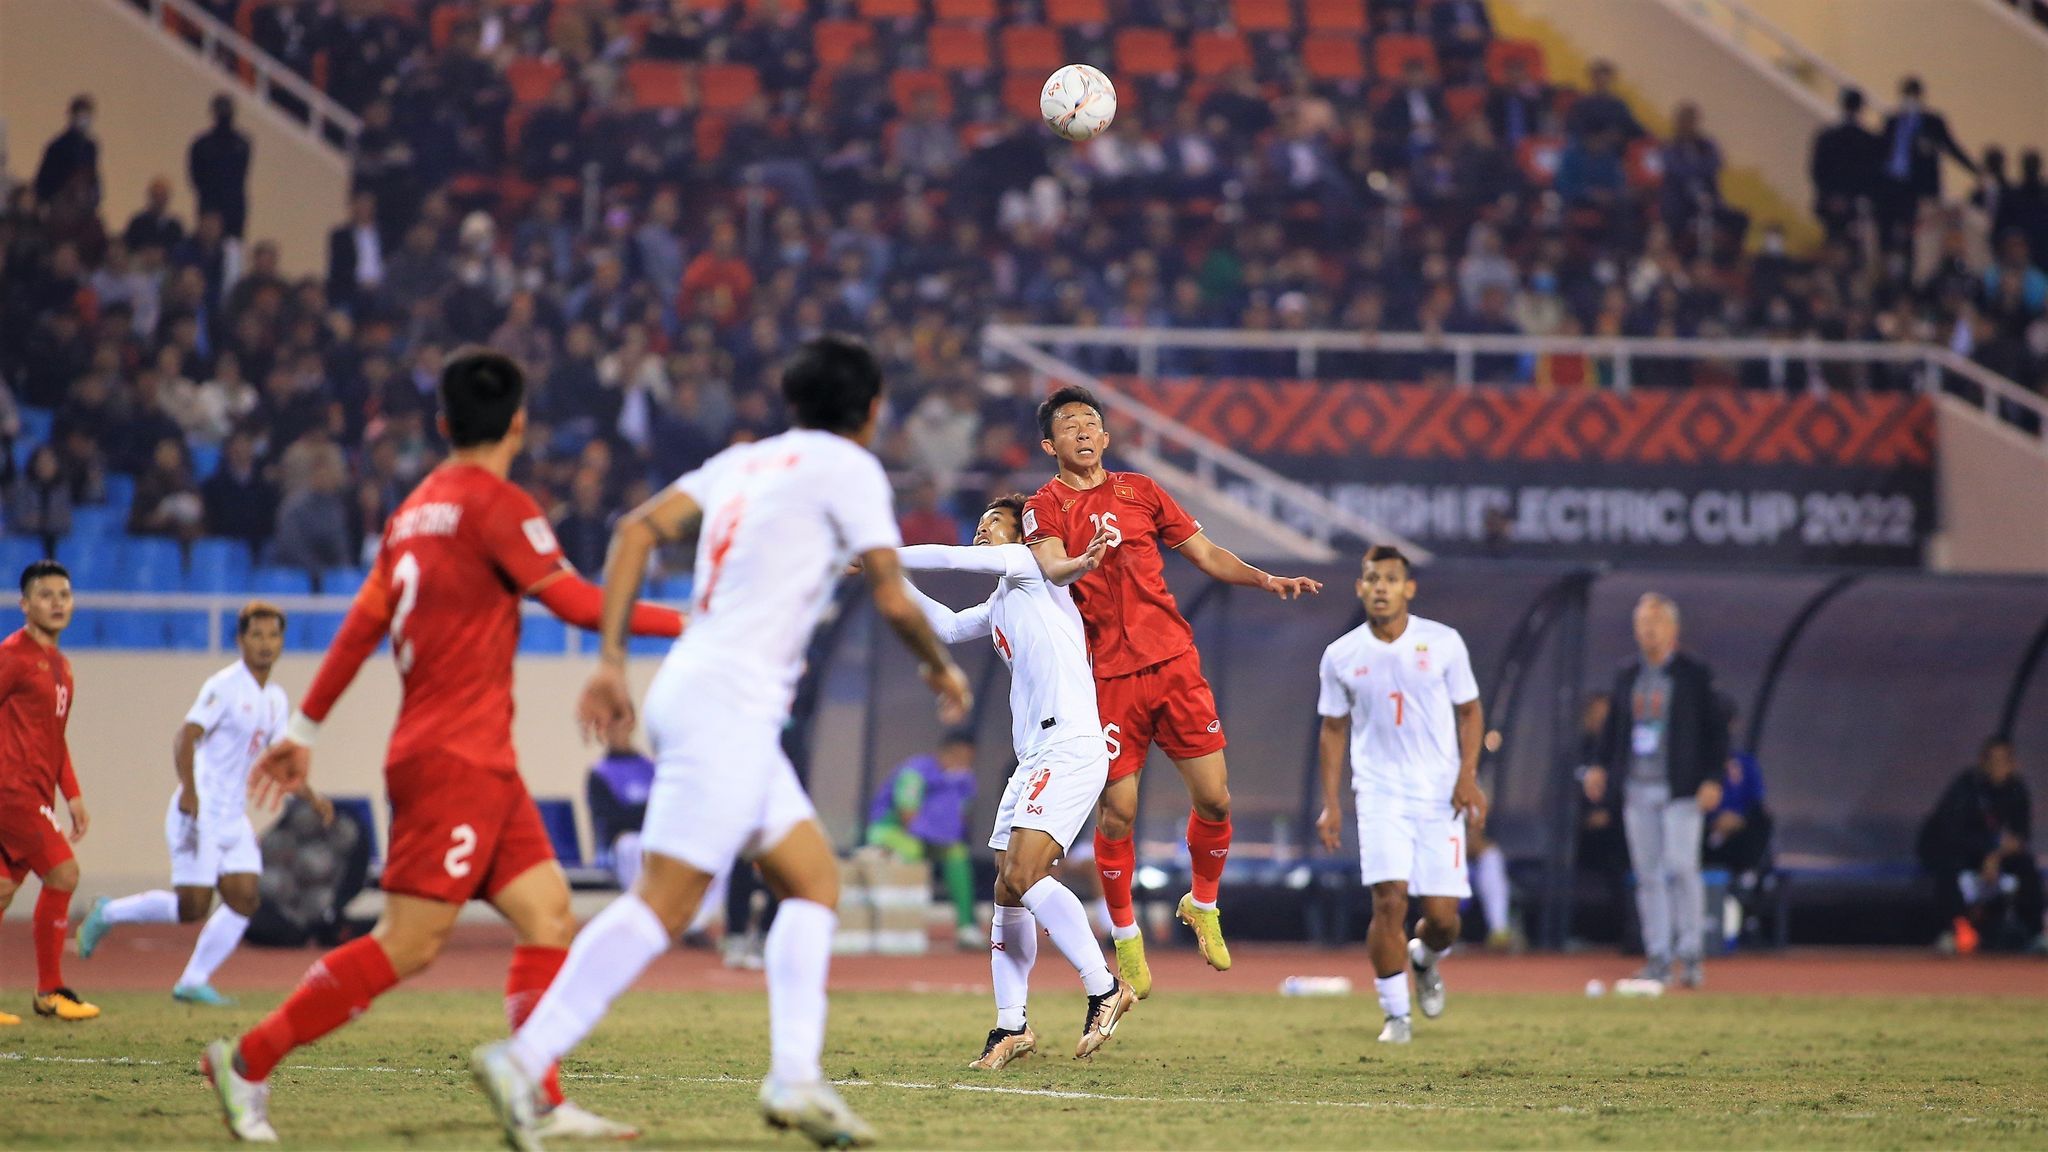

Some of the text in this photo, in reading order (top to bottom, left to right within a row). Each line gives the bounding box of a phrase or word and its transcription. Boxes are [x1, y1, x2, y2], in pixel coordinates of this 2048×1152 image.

[1691, 488, 1798, 544] CUP
[1802, 491, 1916, 547] 2022
[390, 551, 421, 675] 2
[1389, 691, 1405, 726] 7
[443, 823, 477, 878] 2
[1449, 837, 1460, 868] 7
